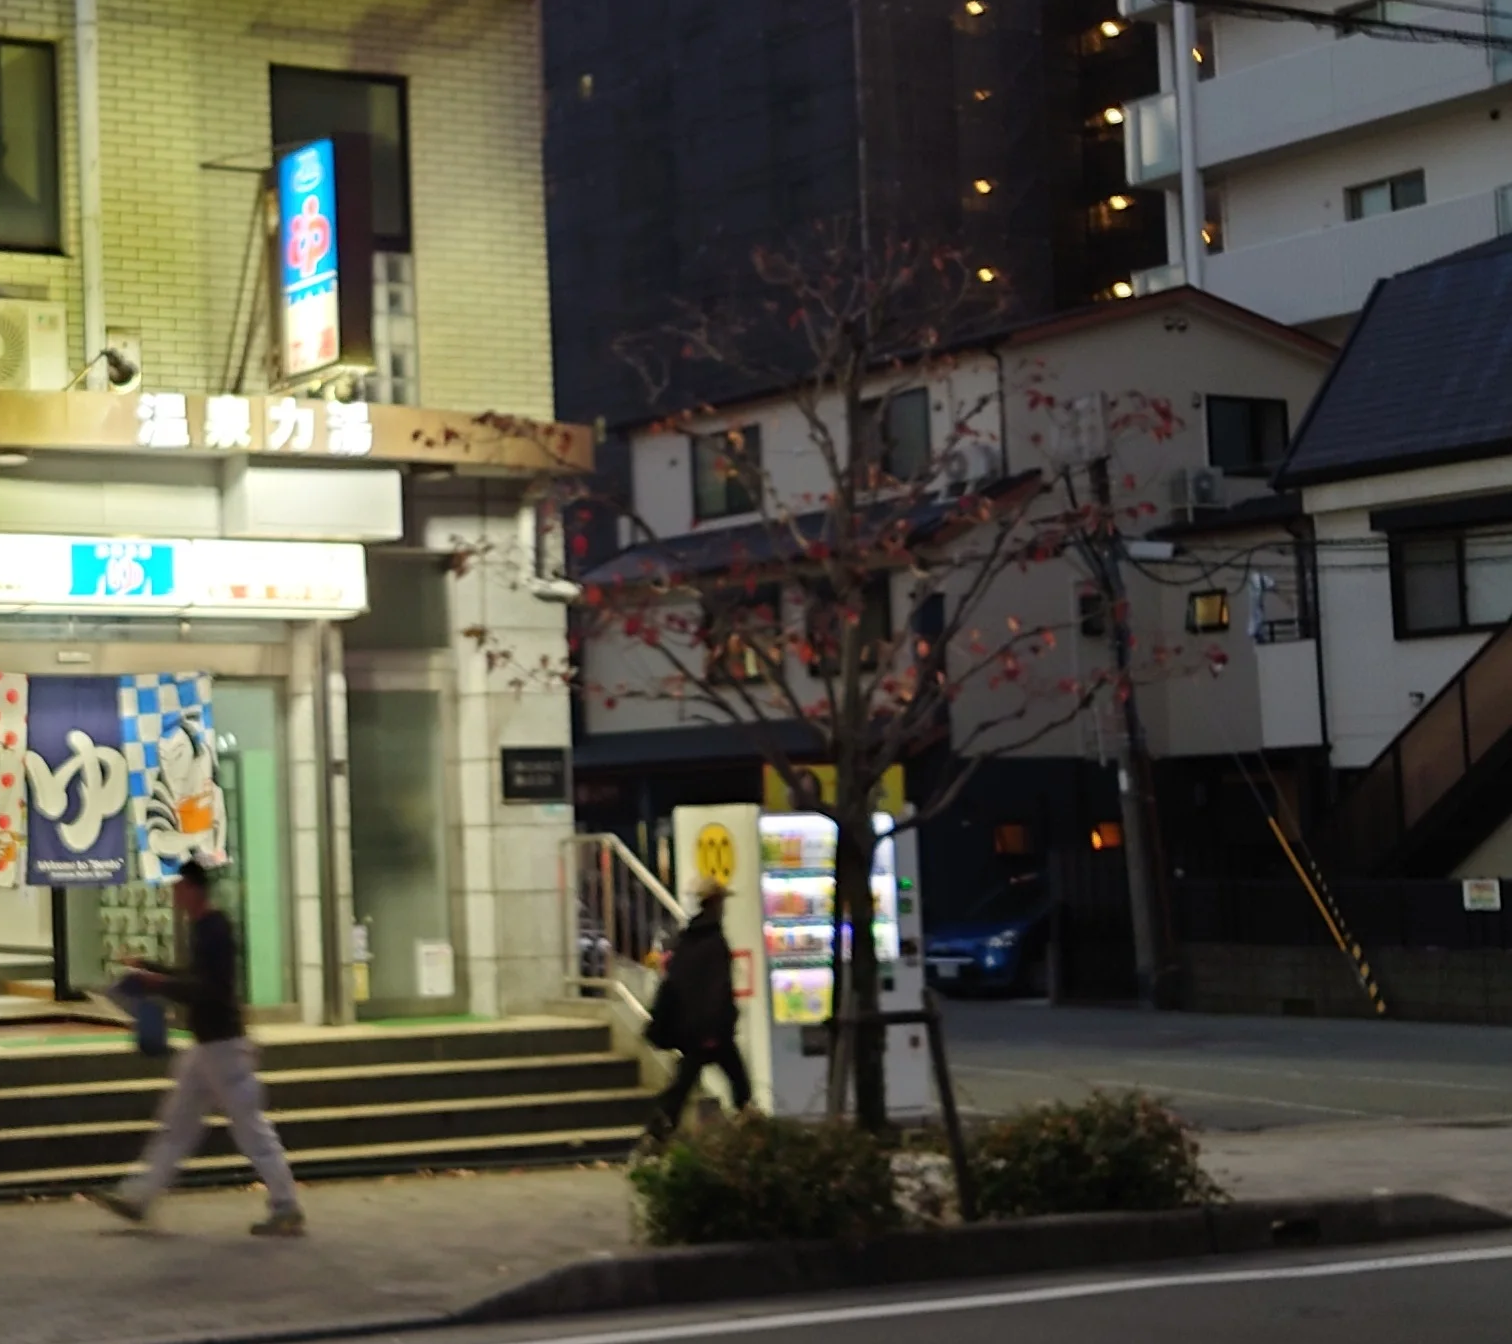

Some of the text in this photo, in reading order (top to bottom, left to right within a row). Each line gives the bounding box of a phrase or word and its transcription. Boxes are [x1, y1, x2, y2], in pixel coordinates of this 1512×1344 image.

[136, 392, 373, 456] 温泉力湯
[26, 729, 128, 852] ゆ
